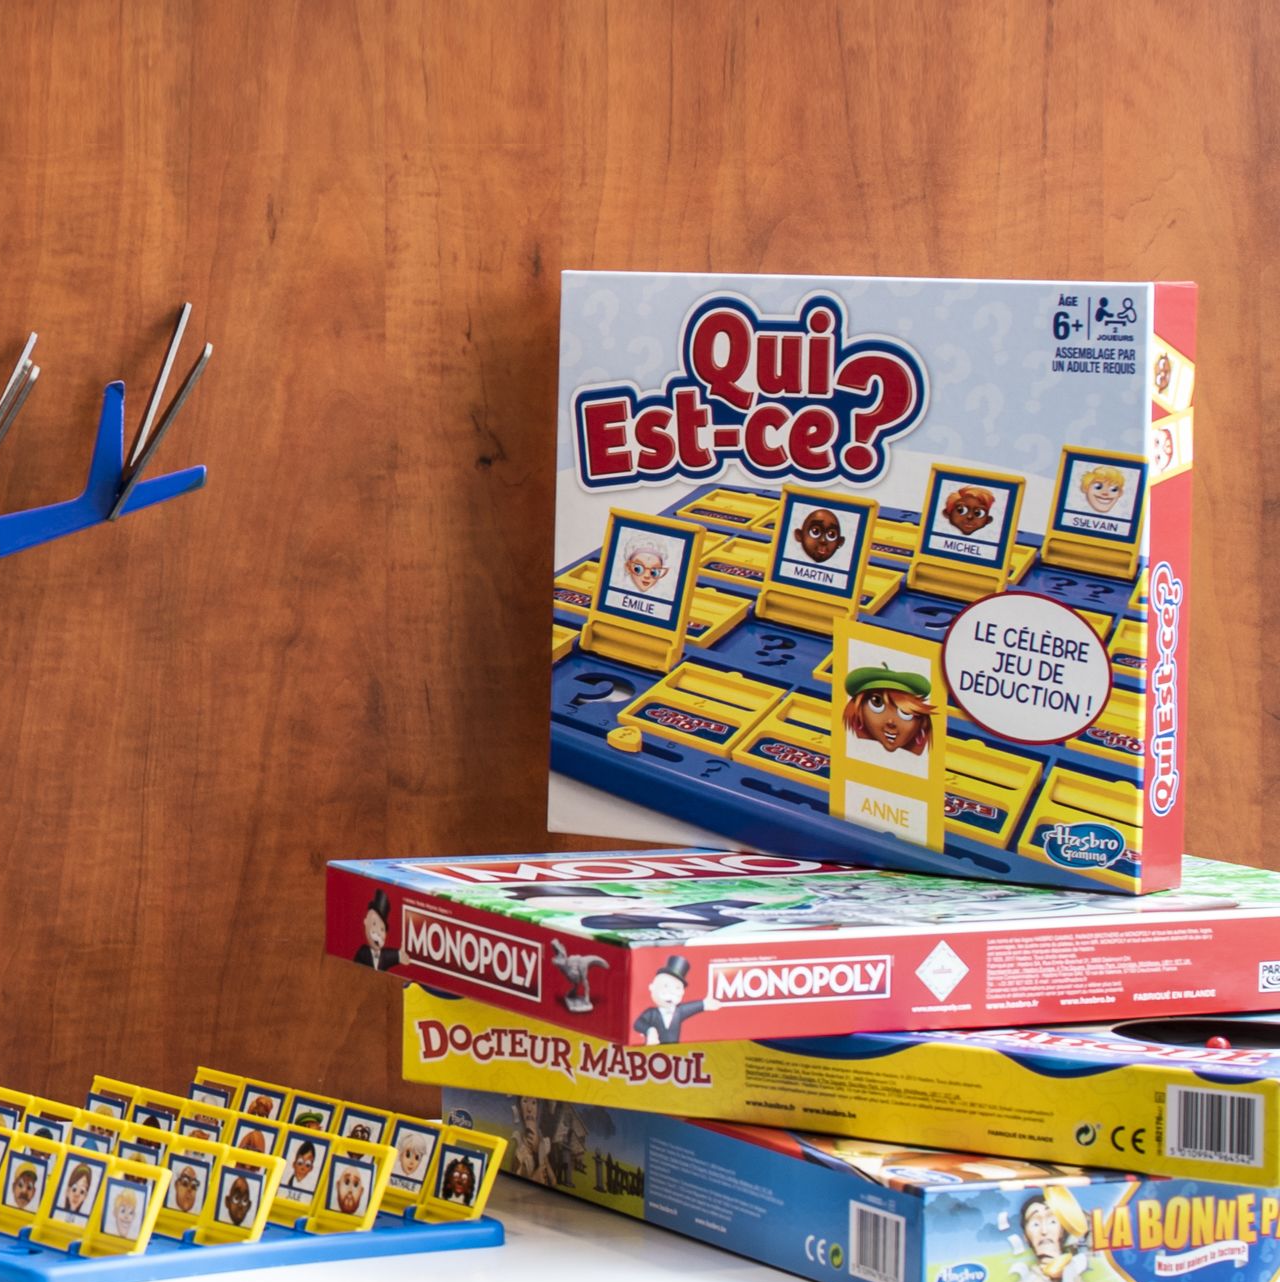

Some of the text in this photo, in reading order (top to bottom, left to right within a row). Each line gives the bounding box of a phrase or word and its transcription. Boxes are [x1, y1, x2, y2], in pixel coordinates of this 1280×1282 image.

[1058, 293, 1078, 306] ÂGE
[1053, 311, 1083, 340] 6+
[692, 309, 831, 410] Qui
[1052, 360, 1136, 374] UN ADULTE REQUIS
[1055, 347, 1136, 360] ASSEMBLAGE PAR
[1073, 516, 1118, 532] SYLVAIN
[943, 540, 981, 556] MICHEL
[794, 565, 833, 584] MARTIN
[622, 595, 654, 614] ÉMILIE
[975, 621, 1089, 663] LE CÉLÈBRE
[992, 652, 1064, 684] JEU DE
[960, 670, 1080, 714] DÉDUCTION
[1154, 738, 1175, 810] Qui
[861, 797, 909, 828] ANNE
[1044, 825, 1119, 851] Hasbro
[1061, 847, 1107, 864] Gaming
[407, 916, 538, 989] MONOPOLY
[716, 962, 885, 999] MONOPOLY
[418, 1019, 712, 1084] DOCTEUR MABOUL
[1092, 1206, 1133, 1251] LA
[1138, 1193, 1257, 1250] BONNE
